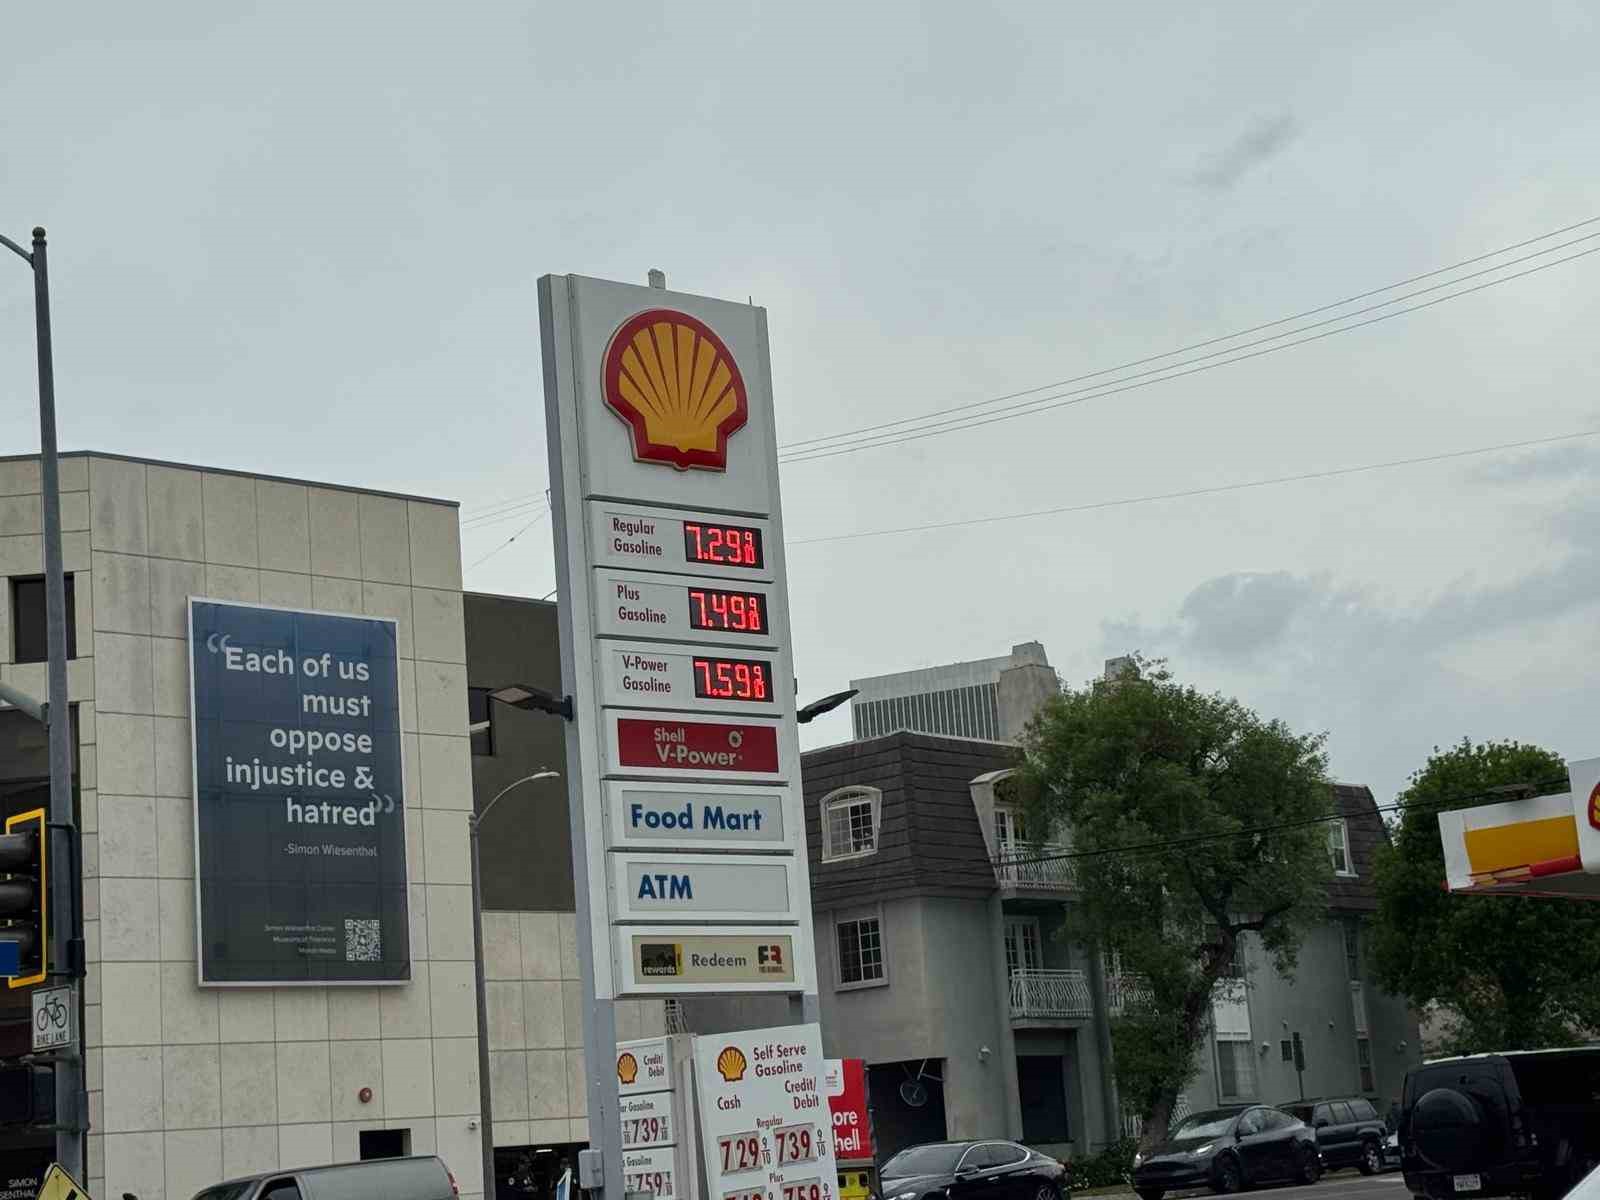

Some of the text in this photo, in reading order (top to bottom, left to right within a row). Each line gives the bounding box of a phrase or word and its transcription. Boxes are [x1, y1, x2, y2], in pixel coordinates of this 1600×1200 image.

[612, 518, 655, 536] Regular
[614, 538, 662, 556] Gasoline
[686, 526, 742, 562] 7.29
[617, 585, 640, 601] Plus
[618, 606, 667, 624] Gasoline
[690, 592, 746, 630] 7.49
[303, 652, 331, 678] of
[339, 660, 370, 681] us
[622, 654, 668, 673] V-Power
[623, 676, 672, 693] Gasoline
[694, 661, 751, 698] 7.59
[303, 693, 371, 717] must
[270, 728, 373, 755] oppose
[653, 727, 685, 743] Shell
[656, 745, 737, 766] V-Power
[226, 756, 375, 790] injustice &
[631, 803, 763, 831] Food Mart
[321, 843, 378, 857] Wiesenthal
[637, 874, 694, 900] ATM
[691, 953, 747, 968] Redeem
[36, 1031, 50, 1045] BIKE
[753, 1043, 807, 1061] Self Serve
[648, 1066, 665, 1077] Debit
[755, 1060, 803, 1077] Gasoline
[784, 1076, 817, 1094] Credit/
[717, 1094, 741, 1111] Cash
[793, 1094, 820, 1111] Debit
[756, 1114, 783, 1131] Regular
[833, 1110, 858, 1126] ore
[632, 1118, 659, 1143] 739
[833, 1127, 861, 1152] hell
[720, 1137, 760, 1172] 729
[775, 1129, 811, 1163] 739
[8, 1178, 38, 1188] SIMON
[769, 1172, 784, 1185] Plus
